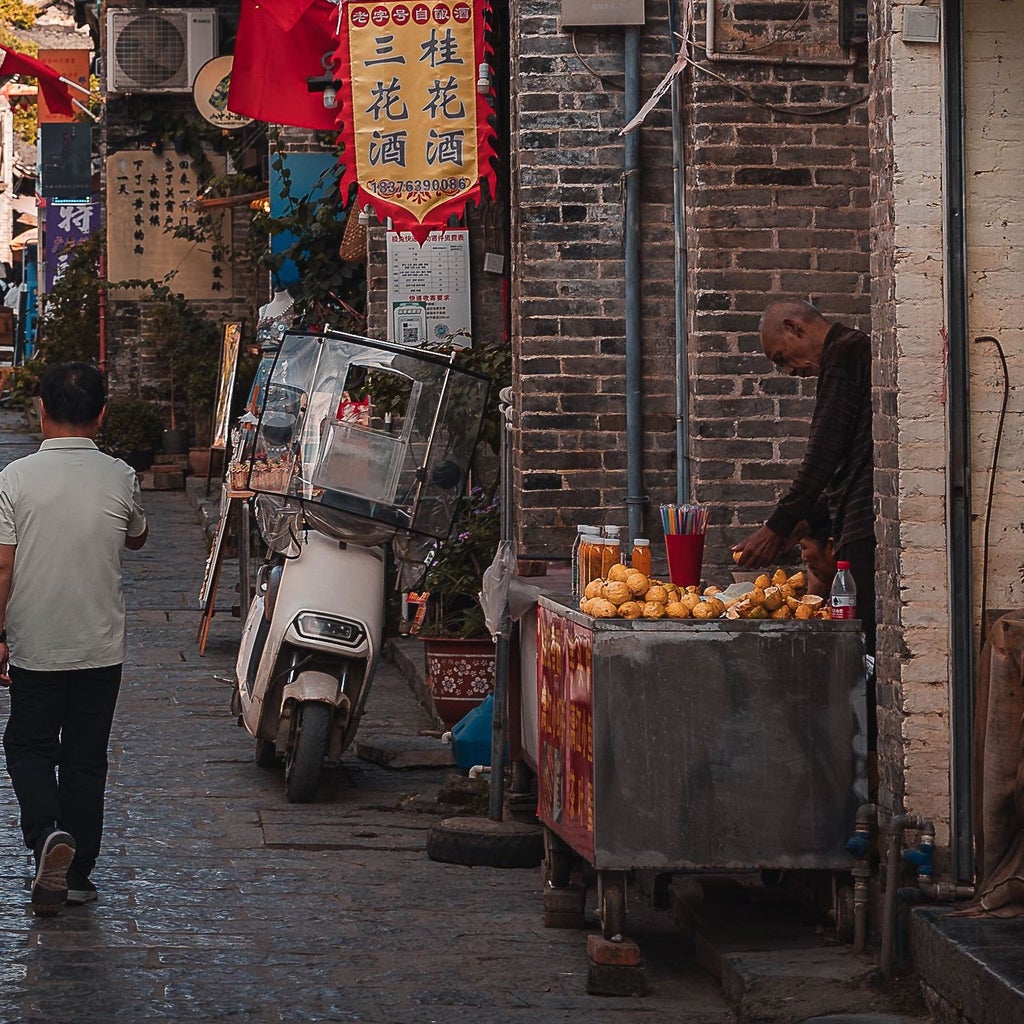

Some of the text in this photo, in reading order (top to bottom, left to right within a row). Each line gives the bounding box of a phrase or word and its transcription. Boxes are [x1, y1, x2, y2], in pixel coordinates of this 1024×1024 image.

[352, 7, 470, 23] 老字号自酿酒
[363, 34, 409, 168] 三花酒
[419, 28, 466, 168] 桂花酒
